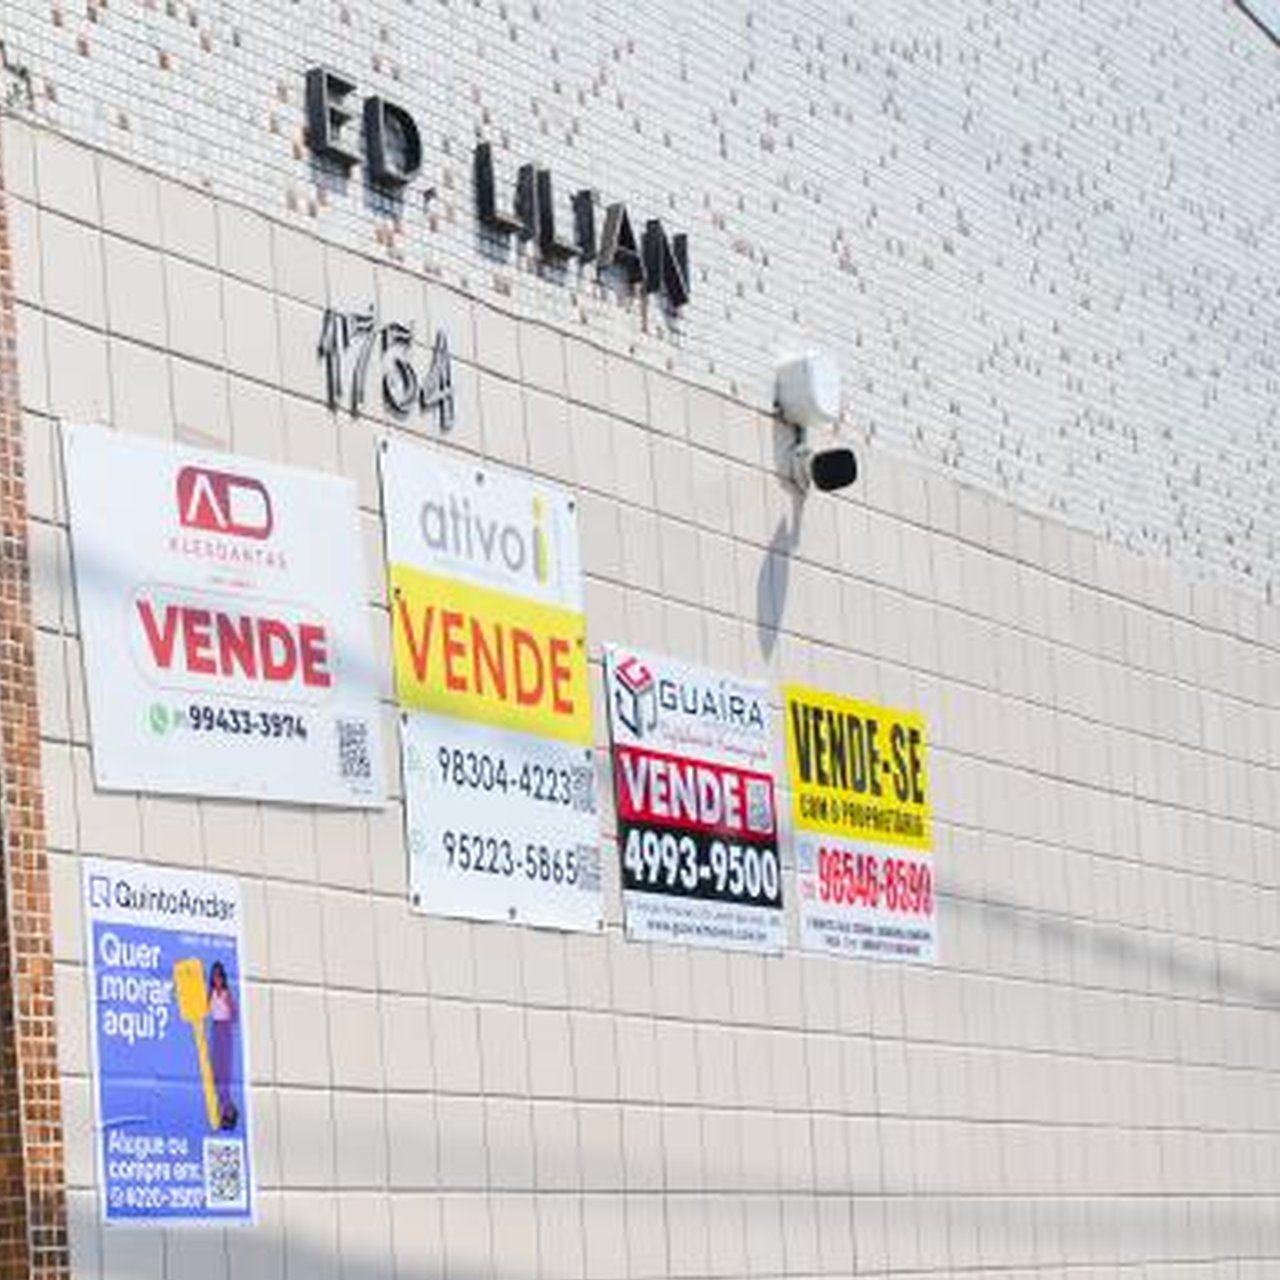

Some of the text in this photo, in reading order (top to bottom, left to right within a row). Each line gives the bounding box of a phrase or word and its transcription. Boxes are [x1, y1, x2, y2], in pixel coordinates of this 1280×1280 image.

[473, 141, 689, 308] LILIAN
[318, 306, 456, 433] 1754
[136, 596, 331, 688] VENDE
[397, 594, 575, 715] VENDE
[437, 745, 572, 806] 98304-4223
[791, 700, 924, 804] VENDE-SE
[619, 752, 742, 828] VENDE
[442, 831, 578, 885] 95223-5865
[624, 829, 778, 900] 4993-9500
[115, 880, 236, 920] QuintoAndar
[100, 932, 161, 969] Quer
[102, 973, 173, 1006] morar
[103, 1006, 169, 1046] aqui?
